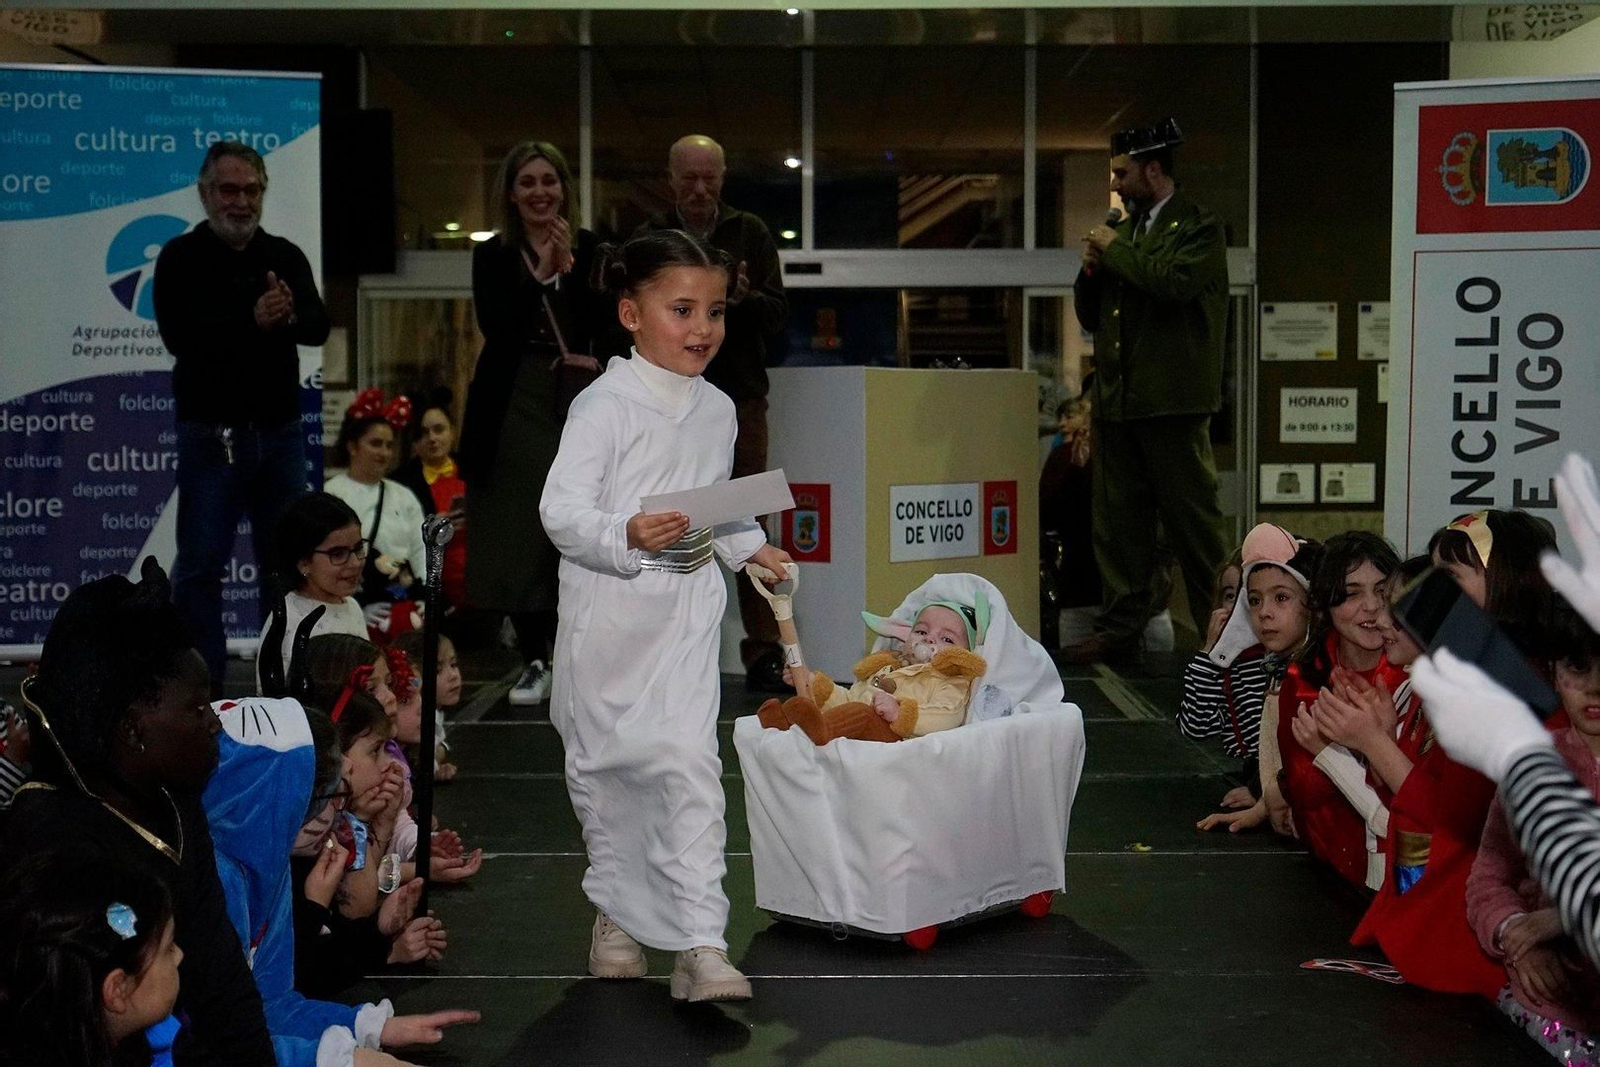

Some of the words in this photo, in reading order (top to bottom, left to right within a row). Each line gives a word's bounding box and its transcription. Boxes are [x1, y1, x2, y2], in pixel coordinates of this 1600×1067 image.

[170, 94, 229, 107] cultura
[74, 127, 176, 152] cultura
[72, 343, 163, 358] Deportivos
[1450, 276, 1501, 505] NCELLO
[1514, 313, 1564, 454] VIGO
[41, 390, 95, 404] cultura
[1289, 396, 1349, 409] HORARIO
[1285, 423, 1297, 432] de
[4, 452, 63, 469] cultura
[72, 481, 139, 499] deporte
[895, 499, 973, 521] CONCELLO
[905, 526, 925, 545] DE
[929, 523, 965, 543] VIGO
[79, 546, 139, 562] deporte
